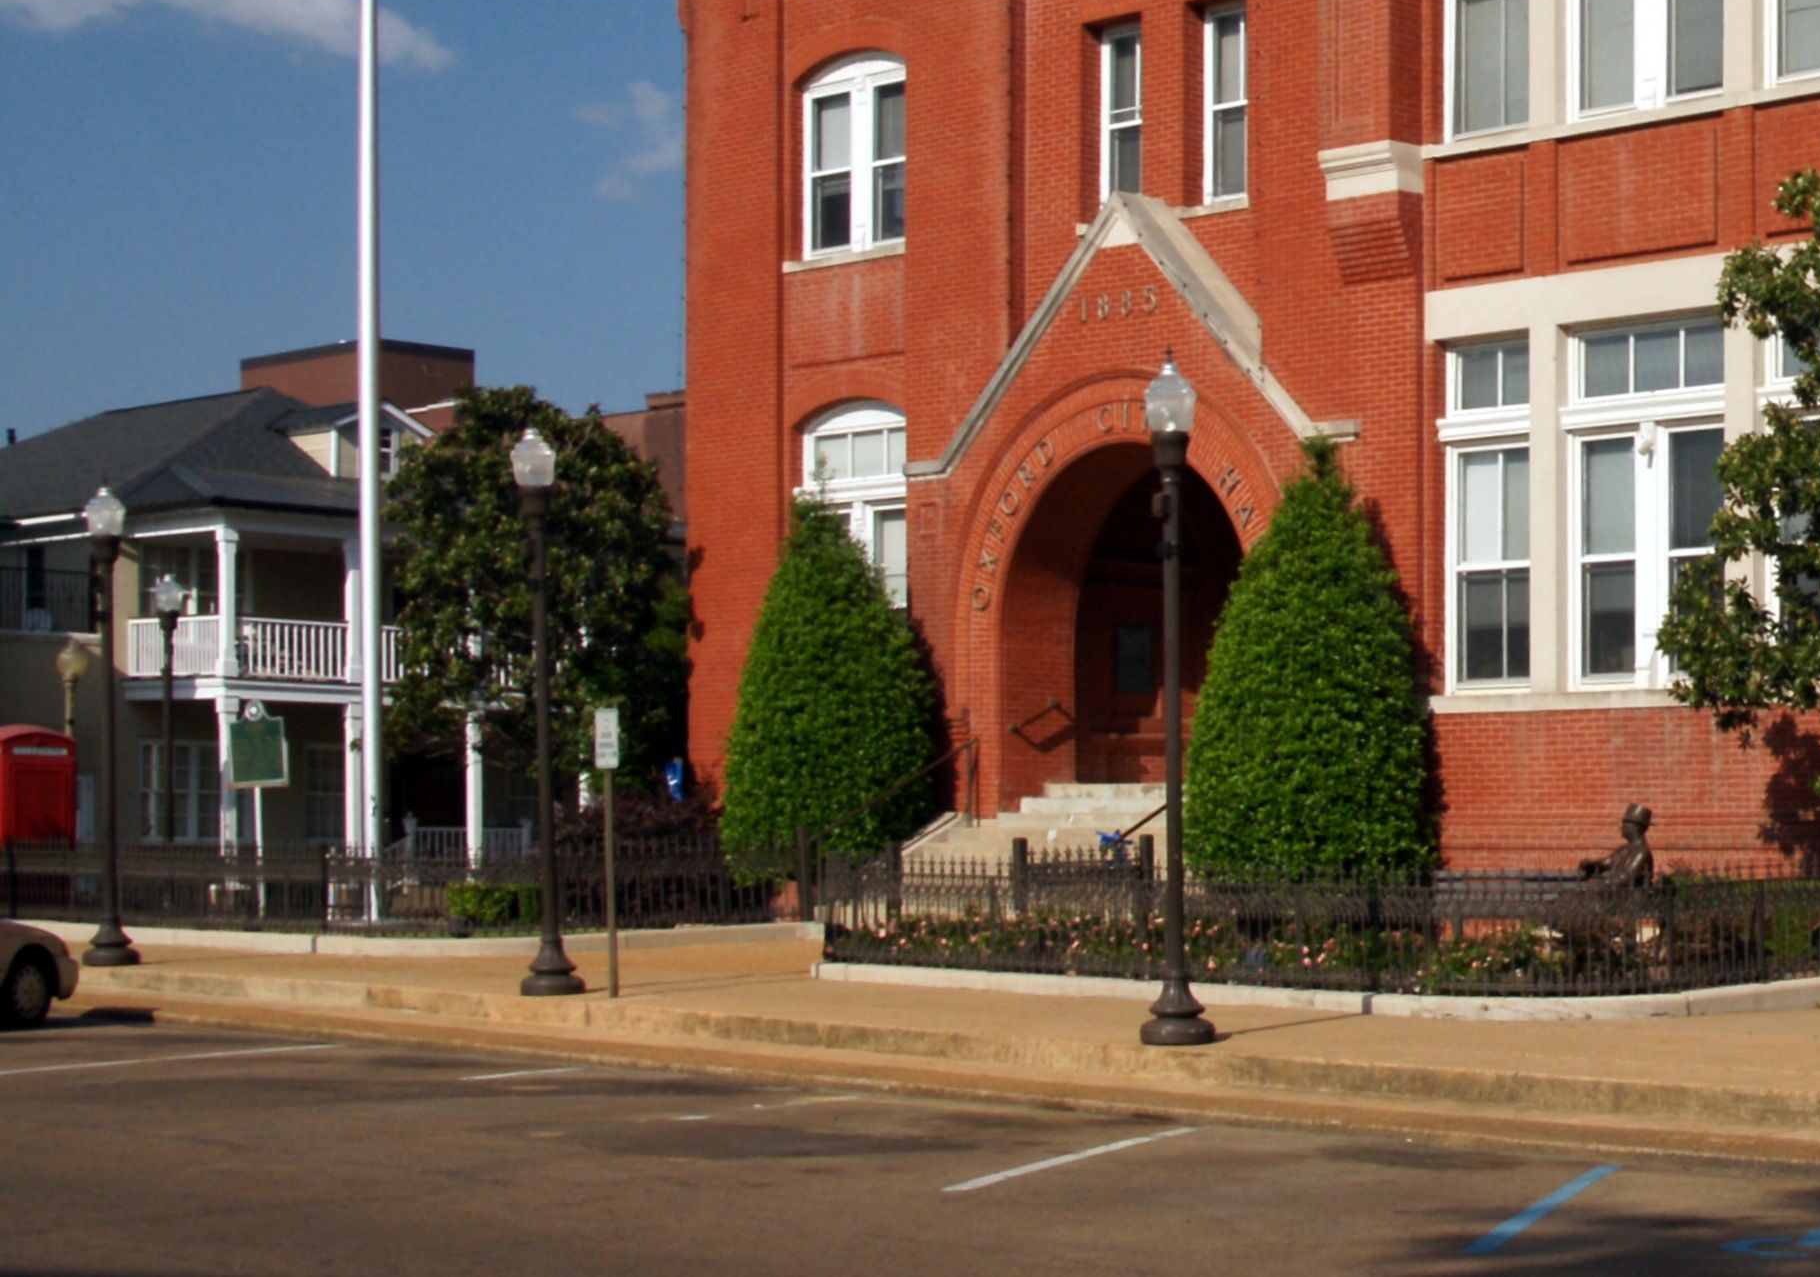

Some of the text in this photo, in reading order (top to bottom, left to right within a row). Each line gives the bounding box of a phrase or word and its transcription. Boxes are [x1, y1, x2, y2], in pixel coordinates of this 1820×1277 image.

[1080, 286, 1159, 324] 1885
[972, 402, 1255, 612] OXFORD CIT HA
